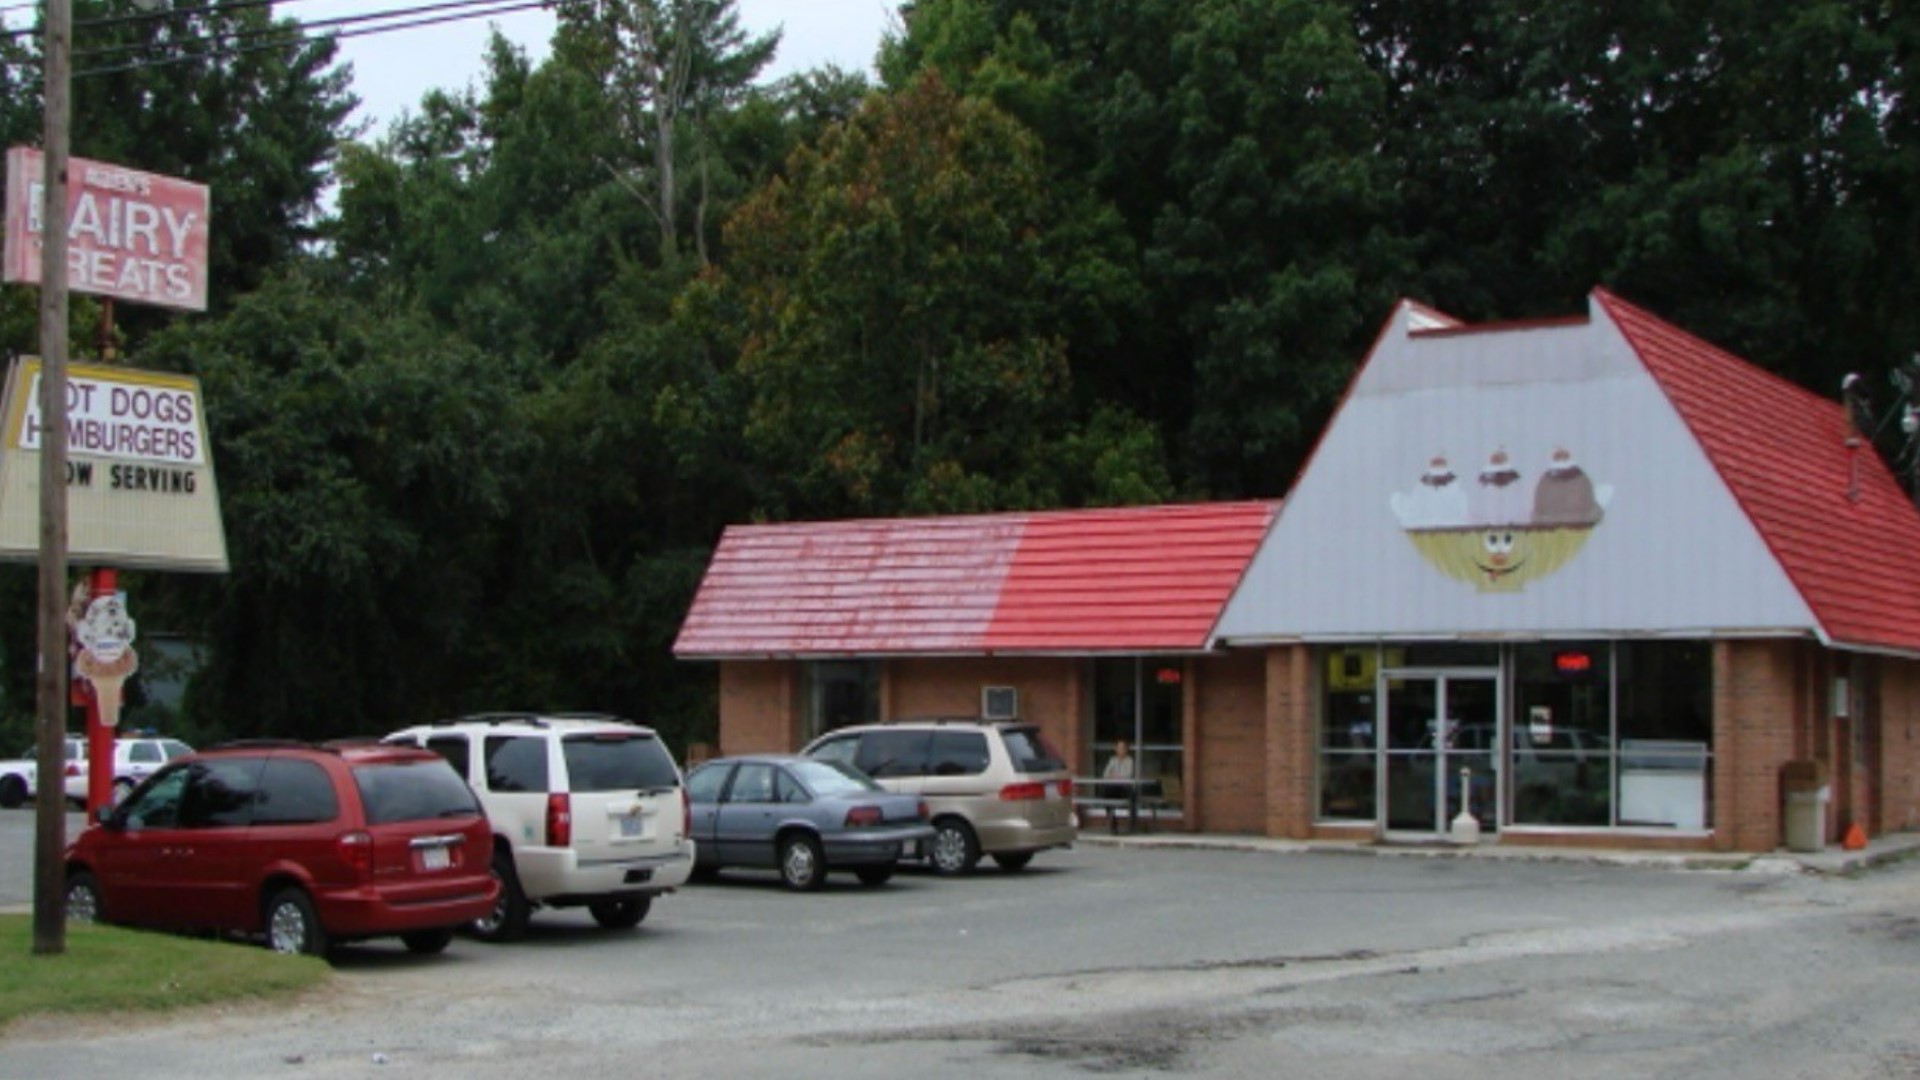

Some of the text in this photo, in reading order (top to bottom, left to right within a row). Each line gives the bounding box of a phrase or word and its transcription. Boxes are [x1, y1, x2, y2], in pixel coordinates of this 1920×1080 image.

[37, 240, 192, 299] REATS
[111, 387, 193, 424] DOGS
[27, 414, 195, 460] HMBURGERS
[110, 463, 196, 493] SERVING
